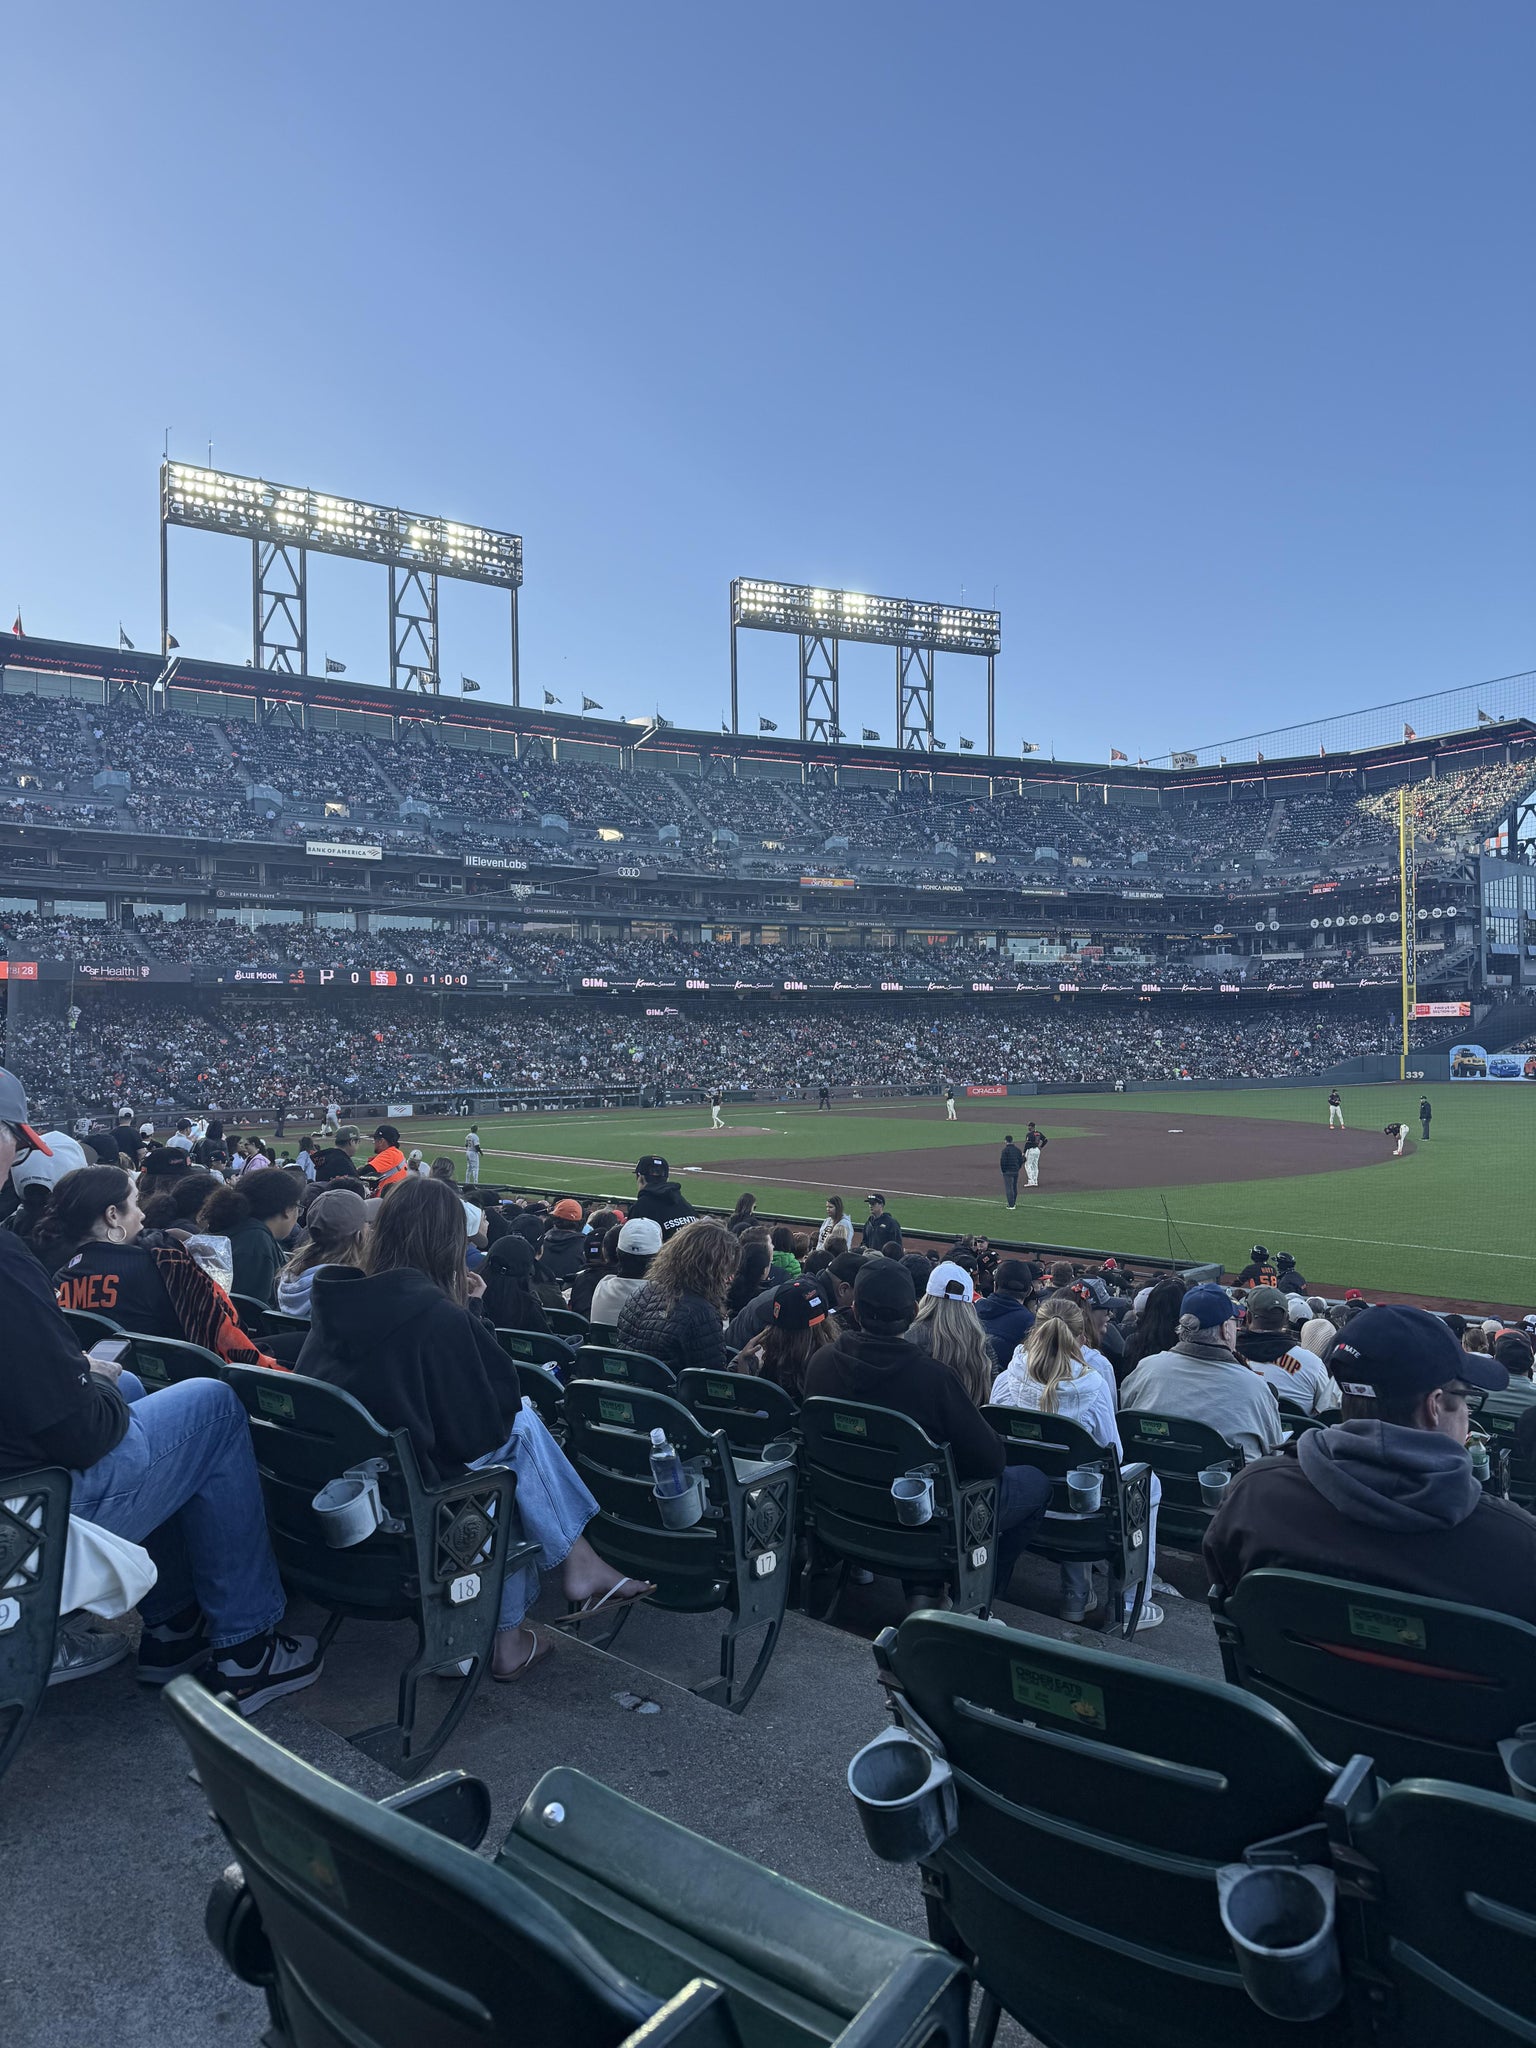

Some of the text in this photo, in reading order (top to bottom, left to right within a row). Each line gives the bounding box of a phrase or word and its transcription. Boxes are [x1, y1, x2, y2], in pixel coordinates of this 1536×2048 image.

[1175, 756, 1195, 764] GIANTS
[22, 966, 33, 974] 28
[80, 966, 135, 976] UCSF Health
[234, 970, 255, 980] BLUE
[297, 970, 304, 979] 3
[320, 970, 334, 985] P
[351, 972, 359, 983] 0
[406, 974, 413, 984] 0
[430, 974, 435, 984] 1
[445, 974, 452, 985] 0
[460, 974, 467, 985] 0
[1259, 1276, 1277, 1288] 58
[1134, 1531, 1141, 1544] 15
[976, 1551, 985, 1564] 16
[761, 1556, 772, 1572] 17
[459, 1579, 474, 1599] 18
